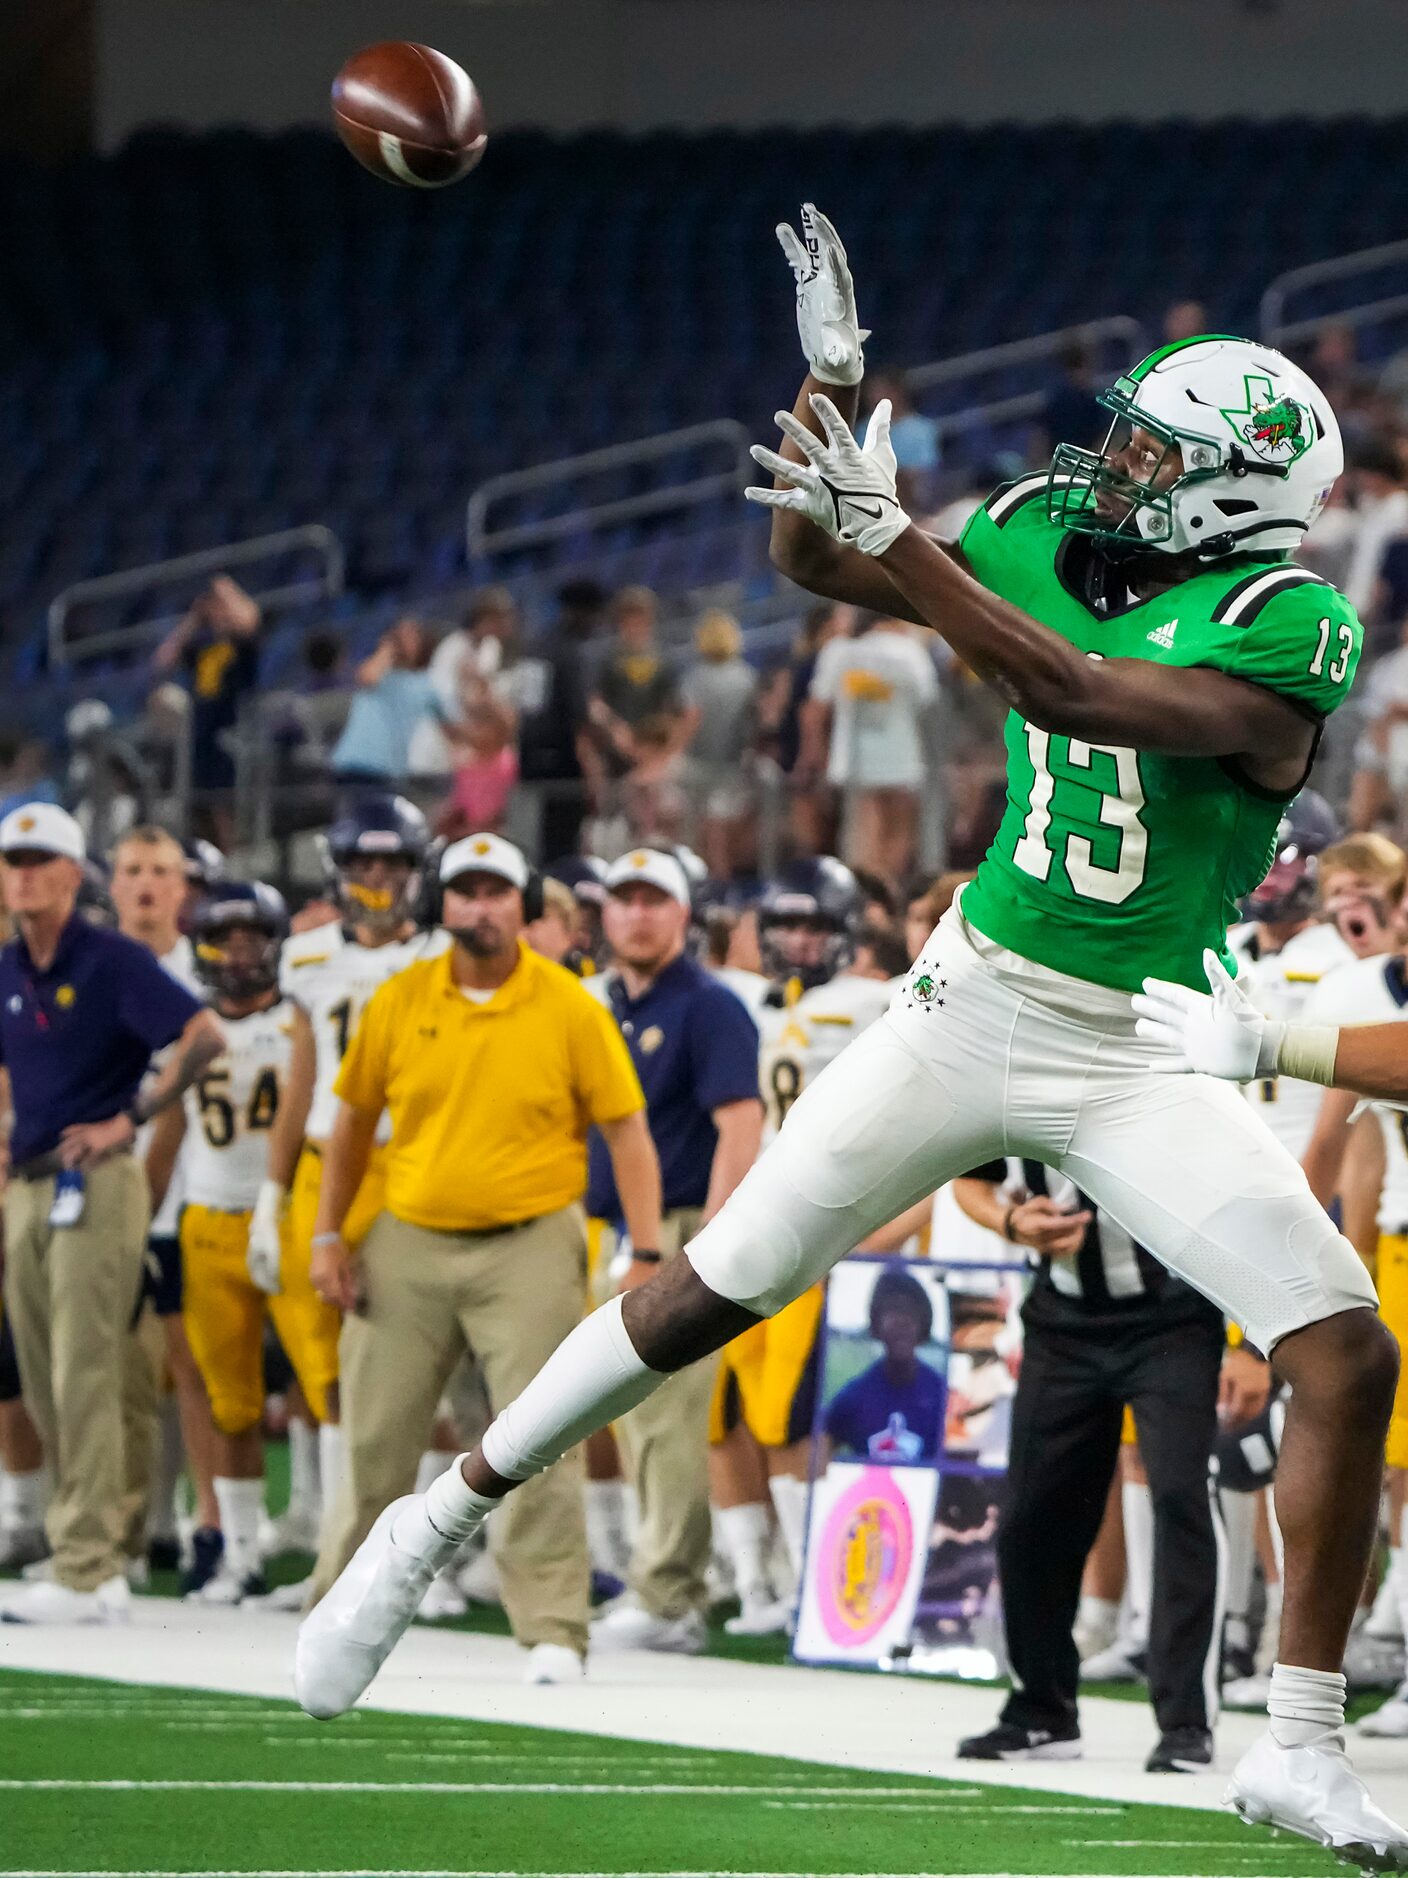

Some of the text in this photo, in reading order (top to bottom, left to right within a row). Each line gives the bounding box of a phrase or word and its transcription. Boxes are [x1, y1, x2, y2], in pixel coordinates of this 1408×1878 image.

[1146, 631, 1174, 649] adidas
[1308, 617, 1355, 684] 13
[1012, 720, 1147, 905] 13
[196, 1066, 281, 1148] 54
